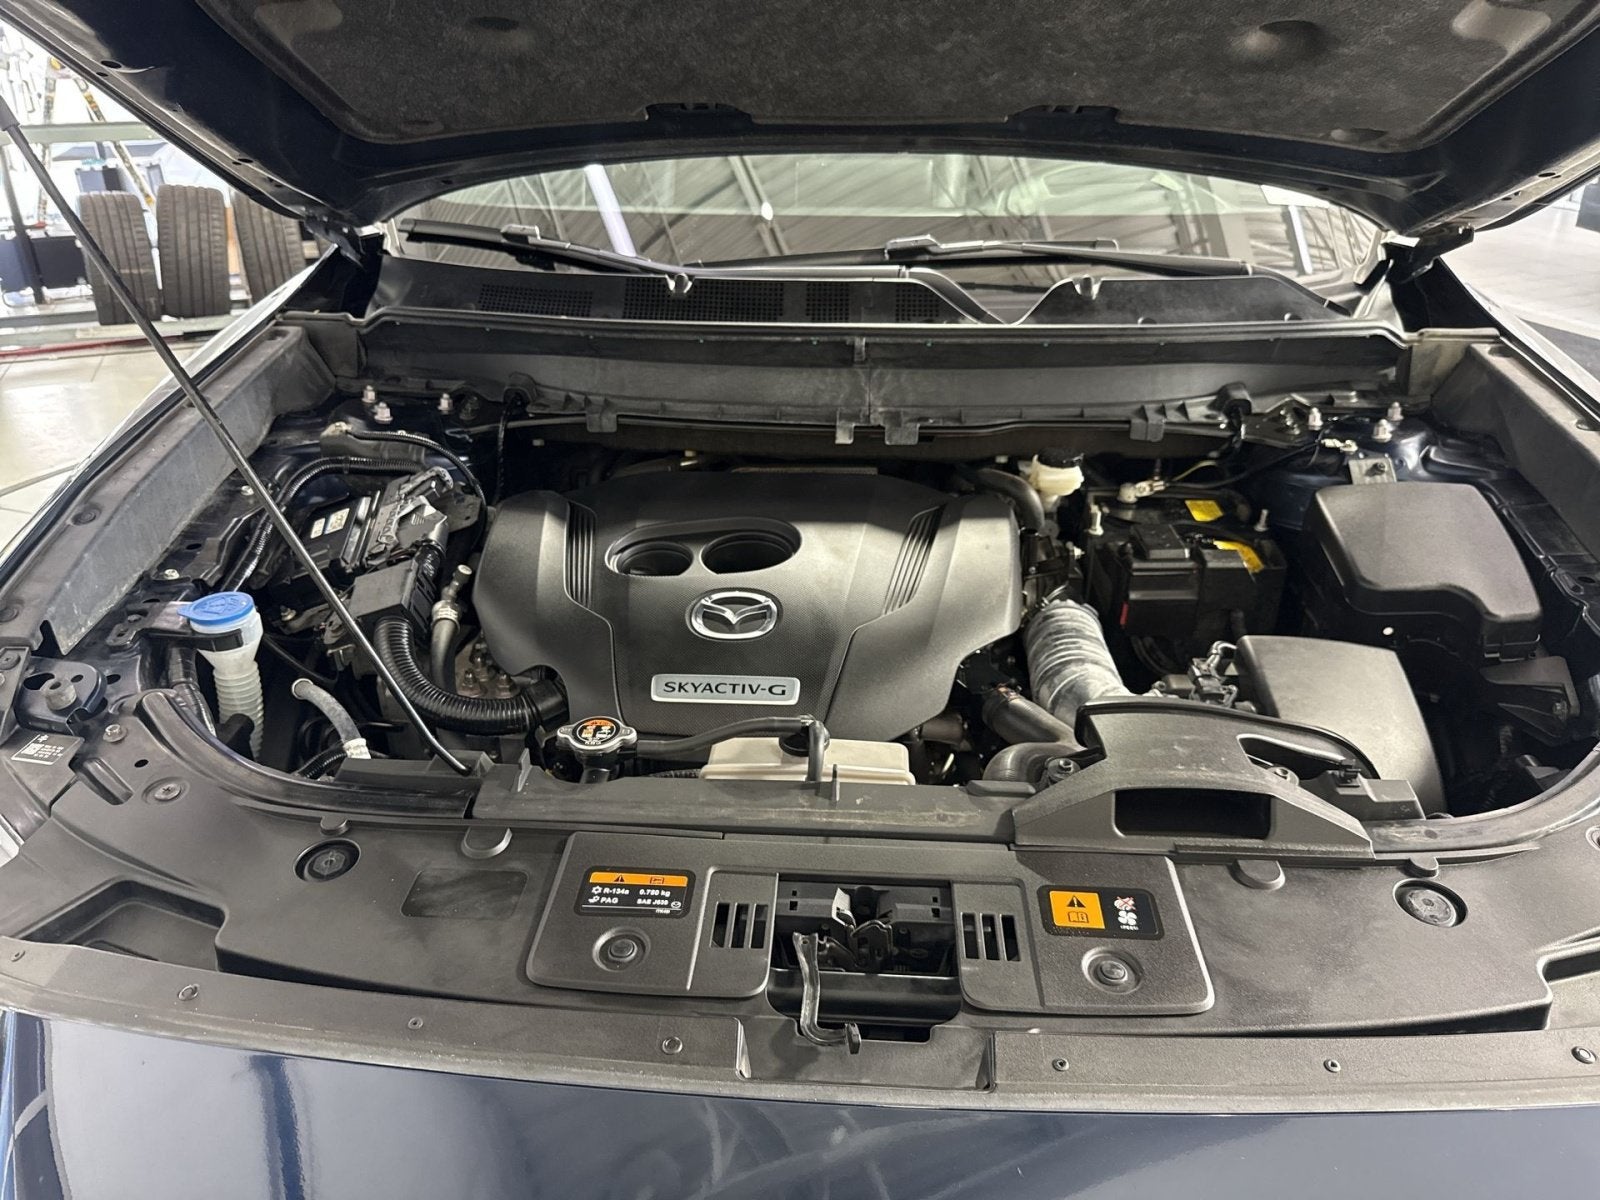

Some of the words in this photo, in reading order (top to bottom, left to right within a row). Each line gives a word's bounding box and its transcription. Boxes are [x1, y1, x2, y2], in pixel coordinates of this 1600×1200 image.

[663, 681, 787, 696] SKYACTIV-G
[603, 887, 630, 895] R-134a
[660, 889, 671, 897] kg
